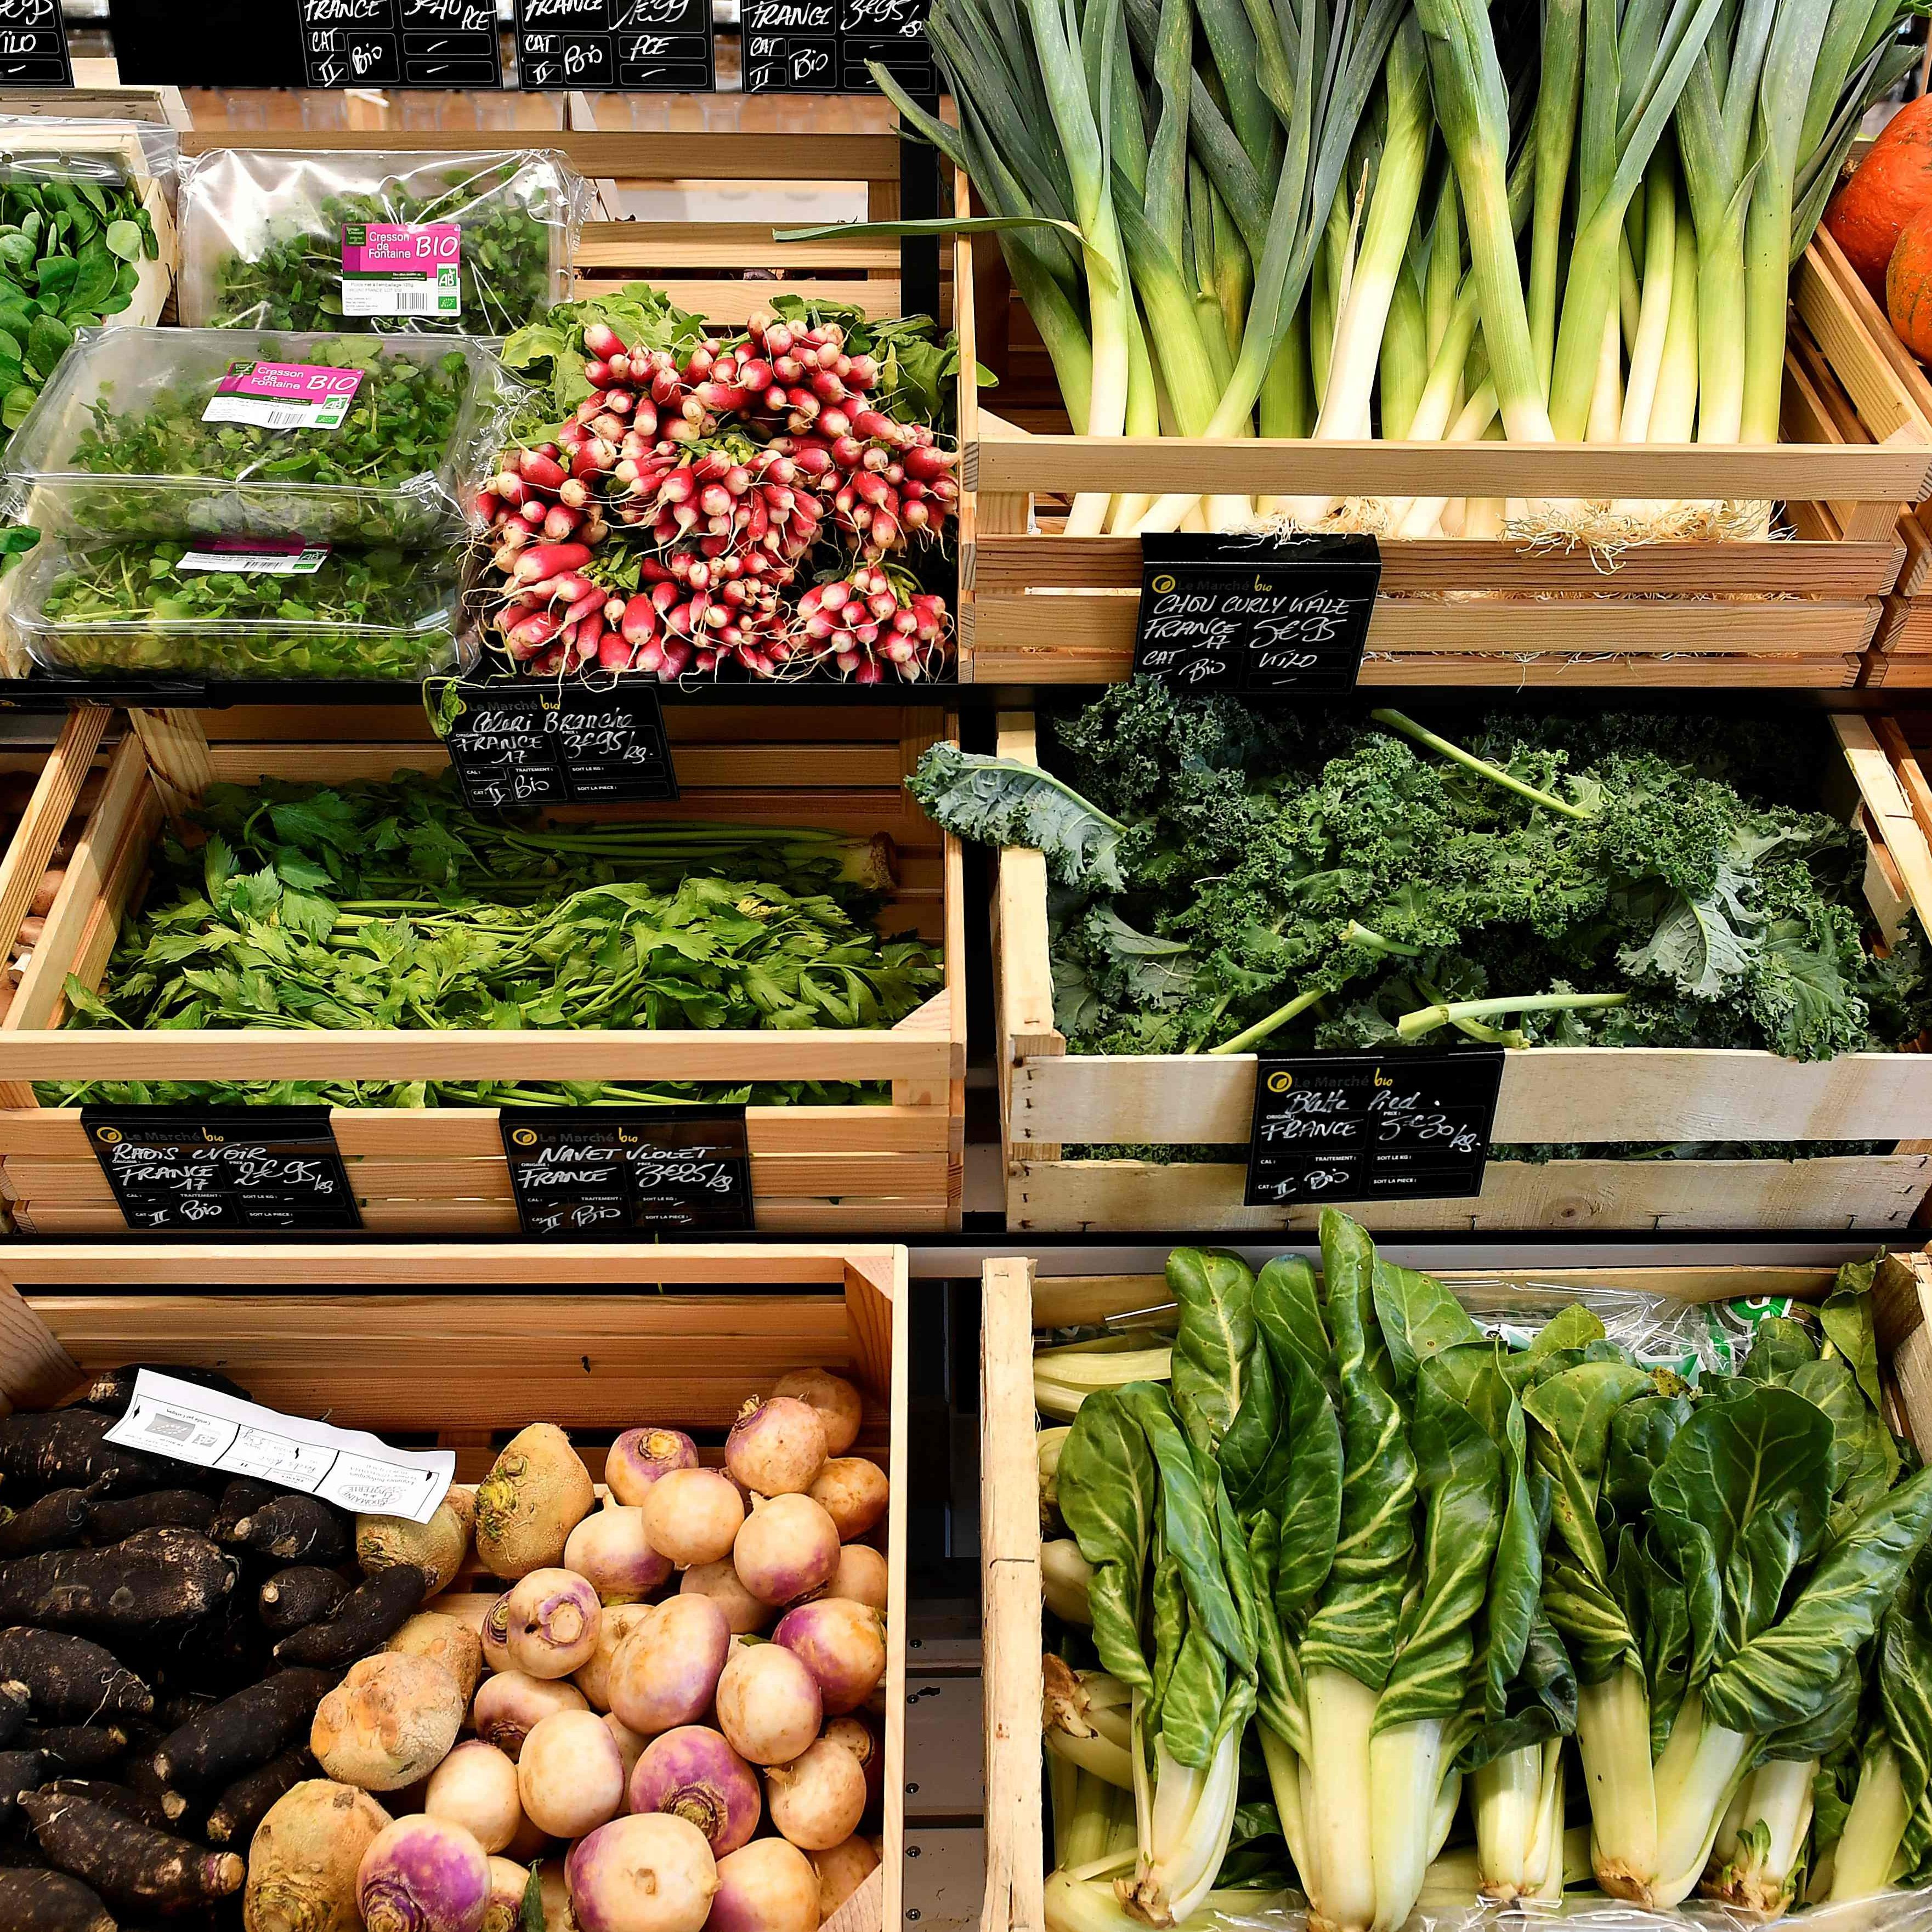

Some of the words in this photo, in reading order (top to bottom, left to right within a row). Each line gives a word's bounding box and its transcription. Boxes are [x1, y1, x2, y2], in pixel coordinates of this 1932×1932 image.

[313, 27, 338, 52] CAT
[525, 35, 556, 52] CAT
[750, 37, 783, 56] CAT
[352, 43, 382, 74] Bio
[564, 44, 603, 75] Bio
[789, 49, 828, 80] Bio
[369, 231, 410, 241] Cresson
[369, 248, 411, 259] Fontaine
[377, 242, 389, 251] de
[416, 236, 458, 257] BIO
[439, 273, 455, 286] AB
[258, 367, 304, 378] Cresson
[251, 377, 301, 389] Fontaine
[307, 375, 358, 390] BIO
[1197, 580, 1249, 591] Marché
[1254, 574, 1273, 592] bio
[1153, 594, 1218, 614] CHOU
[1221, 596, 1288, 614] CURLY
[1144, 615, 1242, 639] FRANCE
[1142, 648, 1187, 665] CAT
[1178, 658, 1226, 684] Bio
[469, 702, 484, 711] Le
[488, 700, 538, 711] Marché
[451, 735, 543, 752] FRANCE
[514, 775, 549, 799] Bio
[1315, 1075, 1369, 1087] Marché
[1374, 1067, 1393, 1087] bio
[124, 1132, 141, 1141] Le
[144, 1132, 201, 1142] Marché
[202, 1126, 224, 1142] bio
[540, 1134, 556, 1142] Le
[560, 1132, 614, 1142] Marché
[619, 1127, 638, 1143] bio
[1261, 1119, 1364, 1141] FRANCE
[537, 1145, 622, 1164] NAVET
[112, 1162, 219, 1186] FRANCE
[518, 1167, 617, 1188] FRANCE
[1304, 1168, 1350, 1189] Bio
[180, 1200, 222, 1221] Bio
[571, 1205, 621, 1227] Bio
